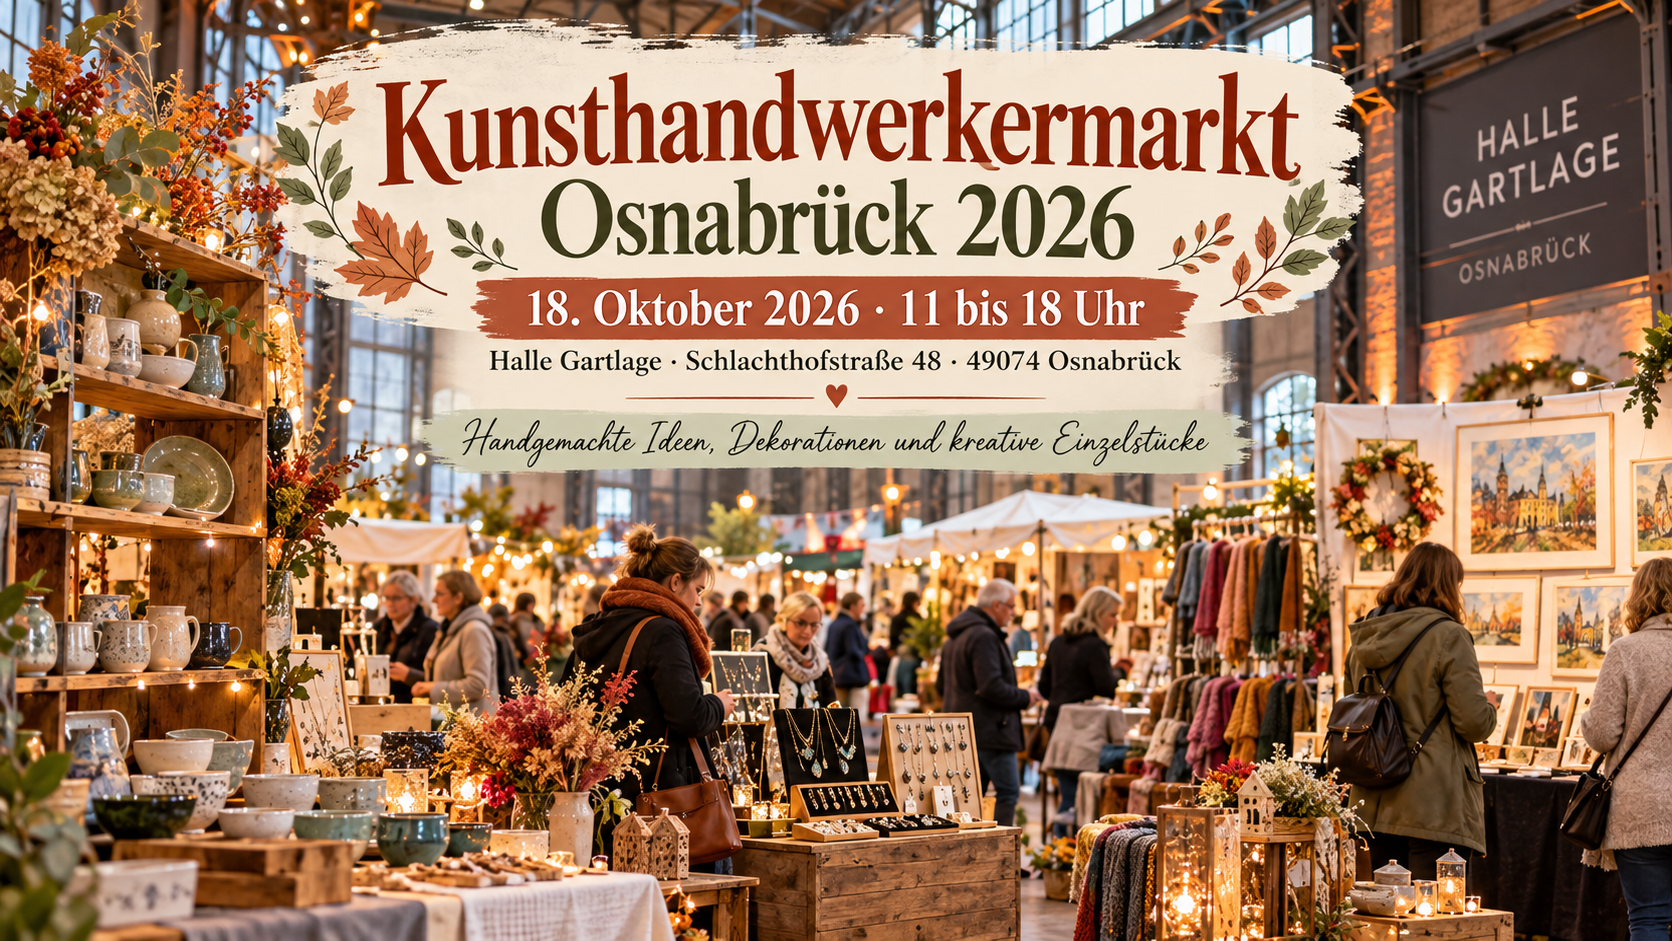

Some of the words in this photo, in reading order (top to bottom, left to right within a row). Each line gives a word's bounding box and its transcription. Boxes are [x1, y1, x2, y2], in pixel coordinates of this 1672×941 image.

[1477, 95, 1579, 162] HALLE
[1442, 132, 1620, 218] GARTLAGE
[1458, 232, 1592, 285] OSNABRÜCK
